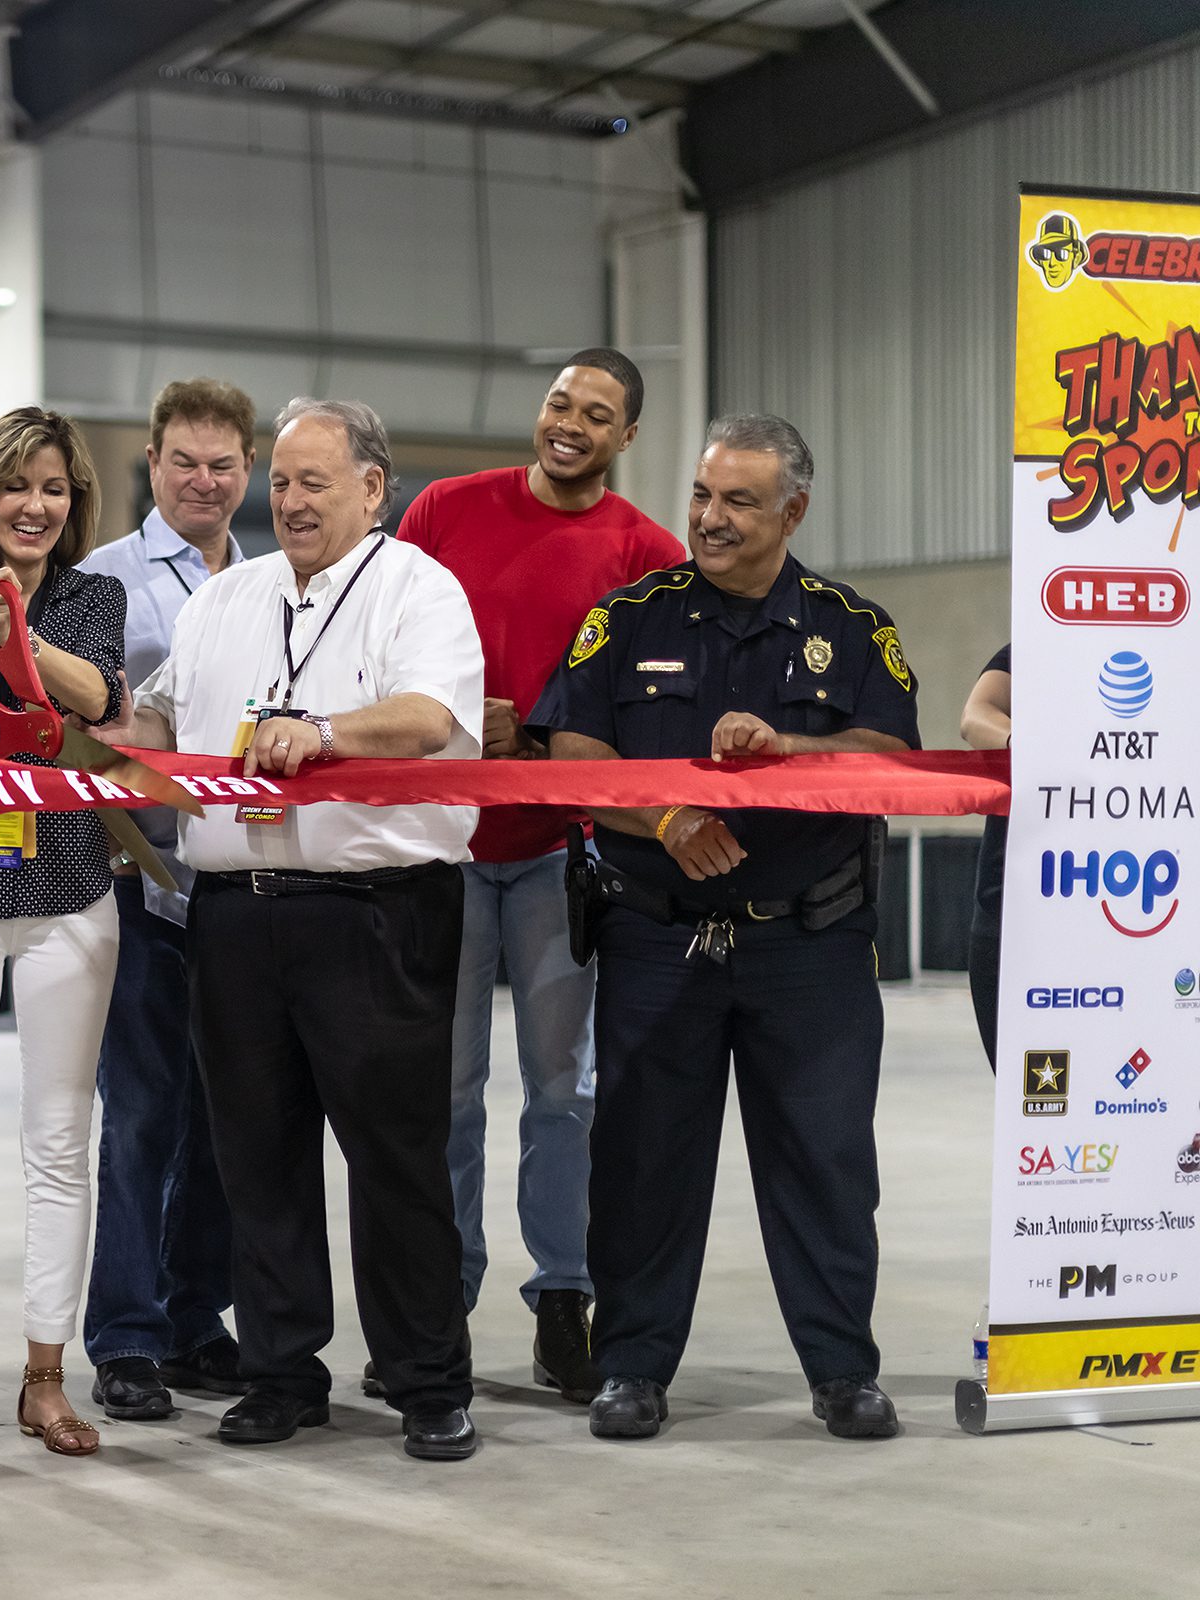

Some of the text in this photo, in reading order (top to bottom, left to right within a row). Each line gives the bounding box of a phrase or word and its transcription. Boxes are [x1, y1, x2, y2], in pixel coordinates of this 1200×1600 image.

[1090, 731, 1159, 760] AT&T
[170, 775, 282, 797] FEST
[1038, 786, 1195, 819] THOMA
[1026, 987, 1124, 1009] GEICO
[1095, 1098, 1167, 1115] Domino's
[1018, 1145, 1055, 1175] SA
[1014, 1210, 1196, 1238] San Antonio Express-News
[1028, 1264, 1179, 1299] THE PM GROUP
[1079, 1352, 1167, 1379] PMX
